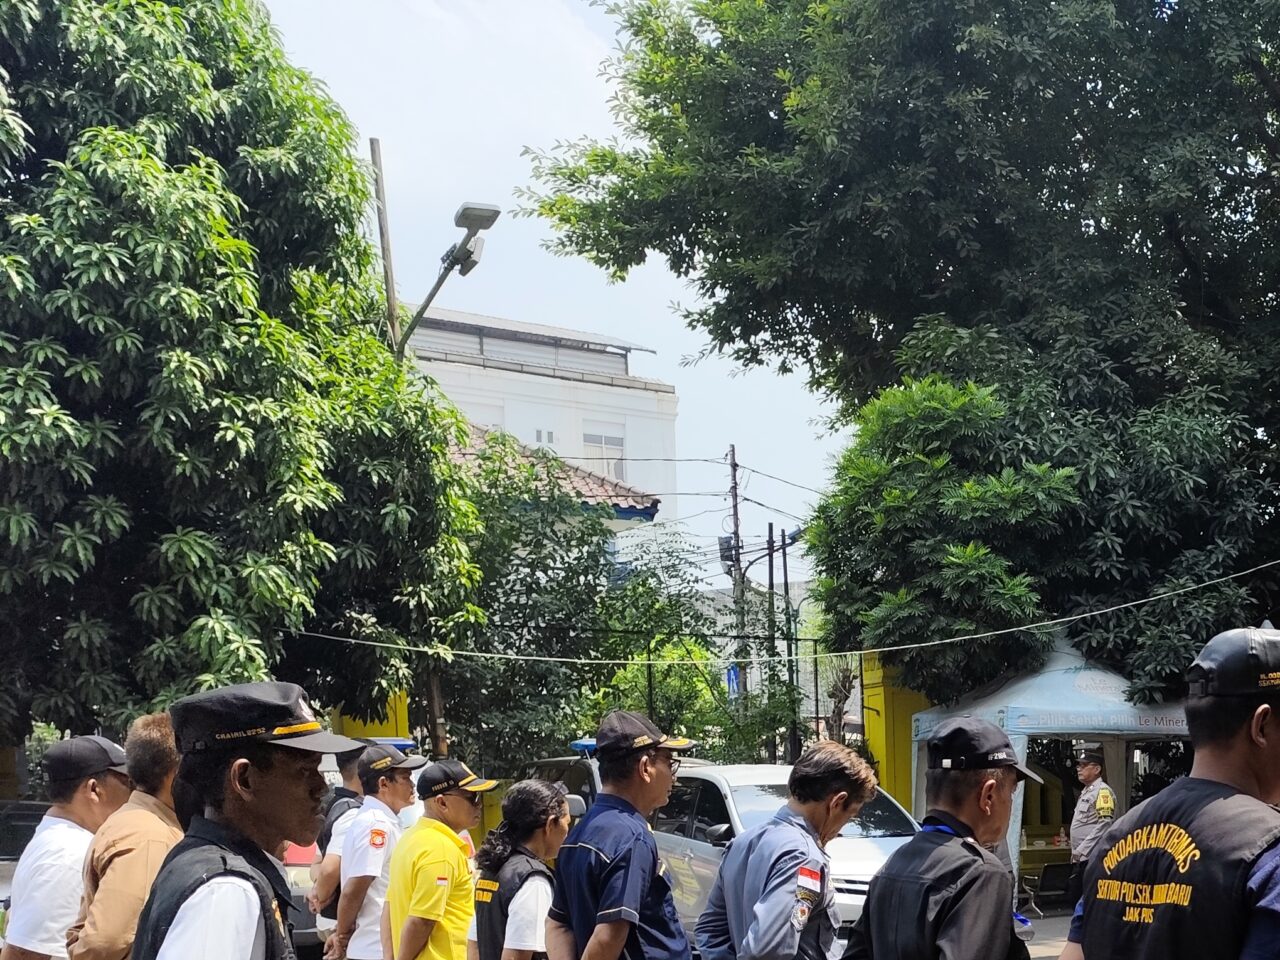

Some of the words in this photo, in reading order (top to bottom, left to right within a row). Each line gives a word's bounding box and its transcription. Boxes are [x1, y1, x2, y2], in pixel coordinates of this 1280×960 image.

[1139, 716, 1150, 726] Le
[1154, 716, 1187, 727] Miner
[1097, 879, 1120, 901] SEKTOR
[1120, 881, 1151, 904] POLSEK
[1167, 882, 1192, 906] BARU
[1122, 906, 1140, 922] JAK
